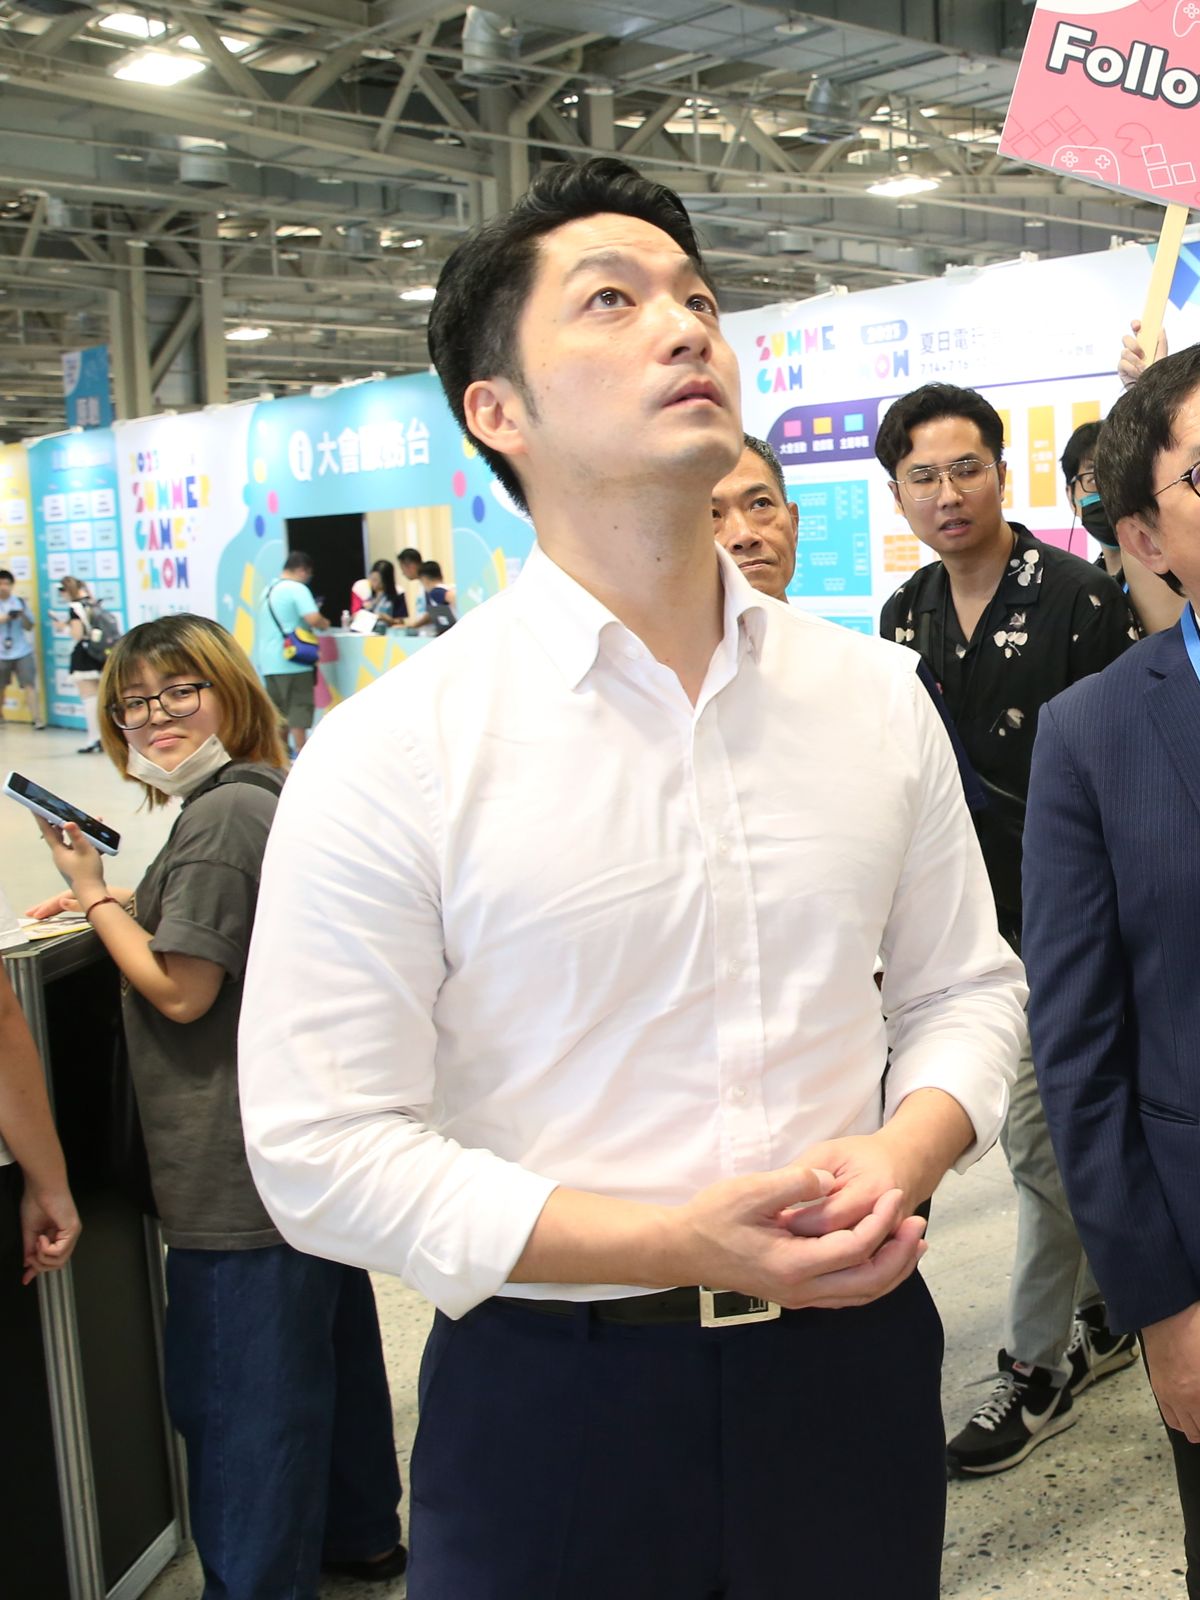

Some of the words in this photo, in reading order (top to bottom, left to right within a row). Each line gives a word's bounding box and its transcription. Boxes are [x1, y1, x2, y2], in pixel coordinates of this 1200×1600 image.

[756, 325, 835, 361] SUMME
[756, 365, 803, 394] GAM
[316, 417, 430, 476] 大會台
[132, 475, 211, 513] SUMMER
[134, 517, 187, 550] GAME
